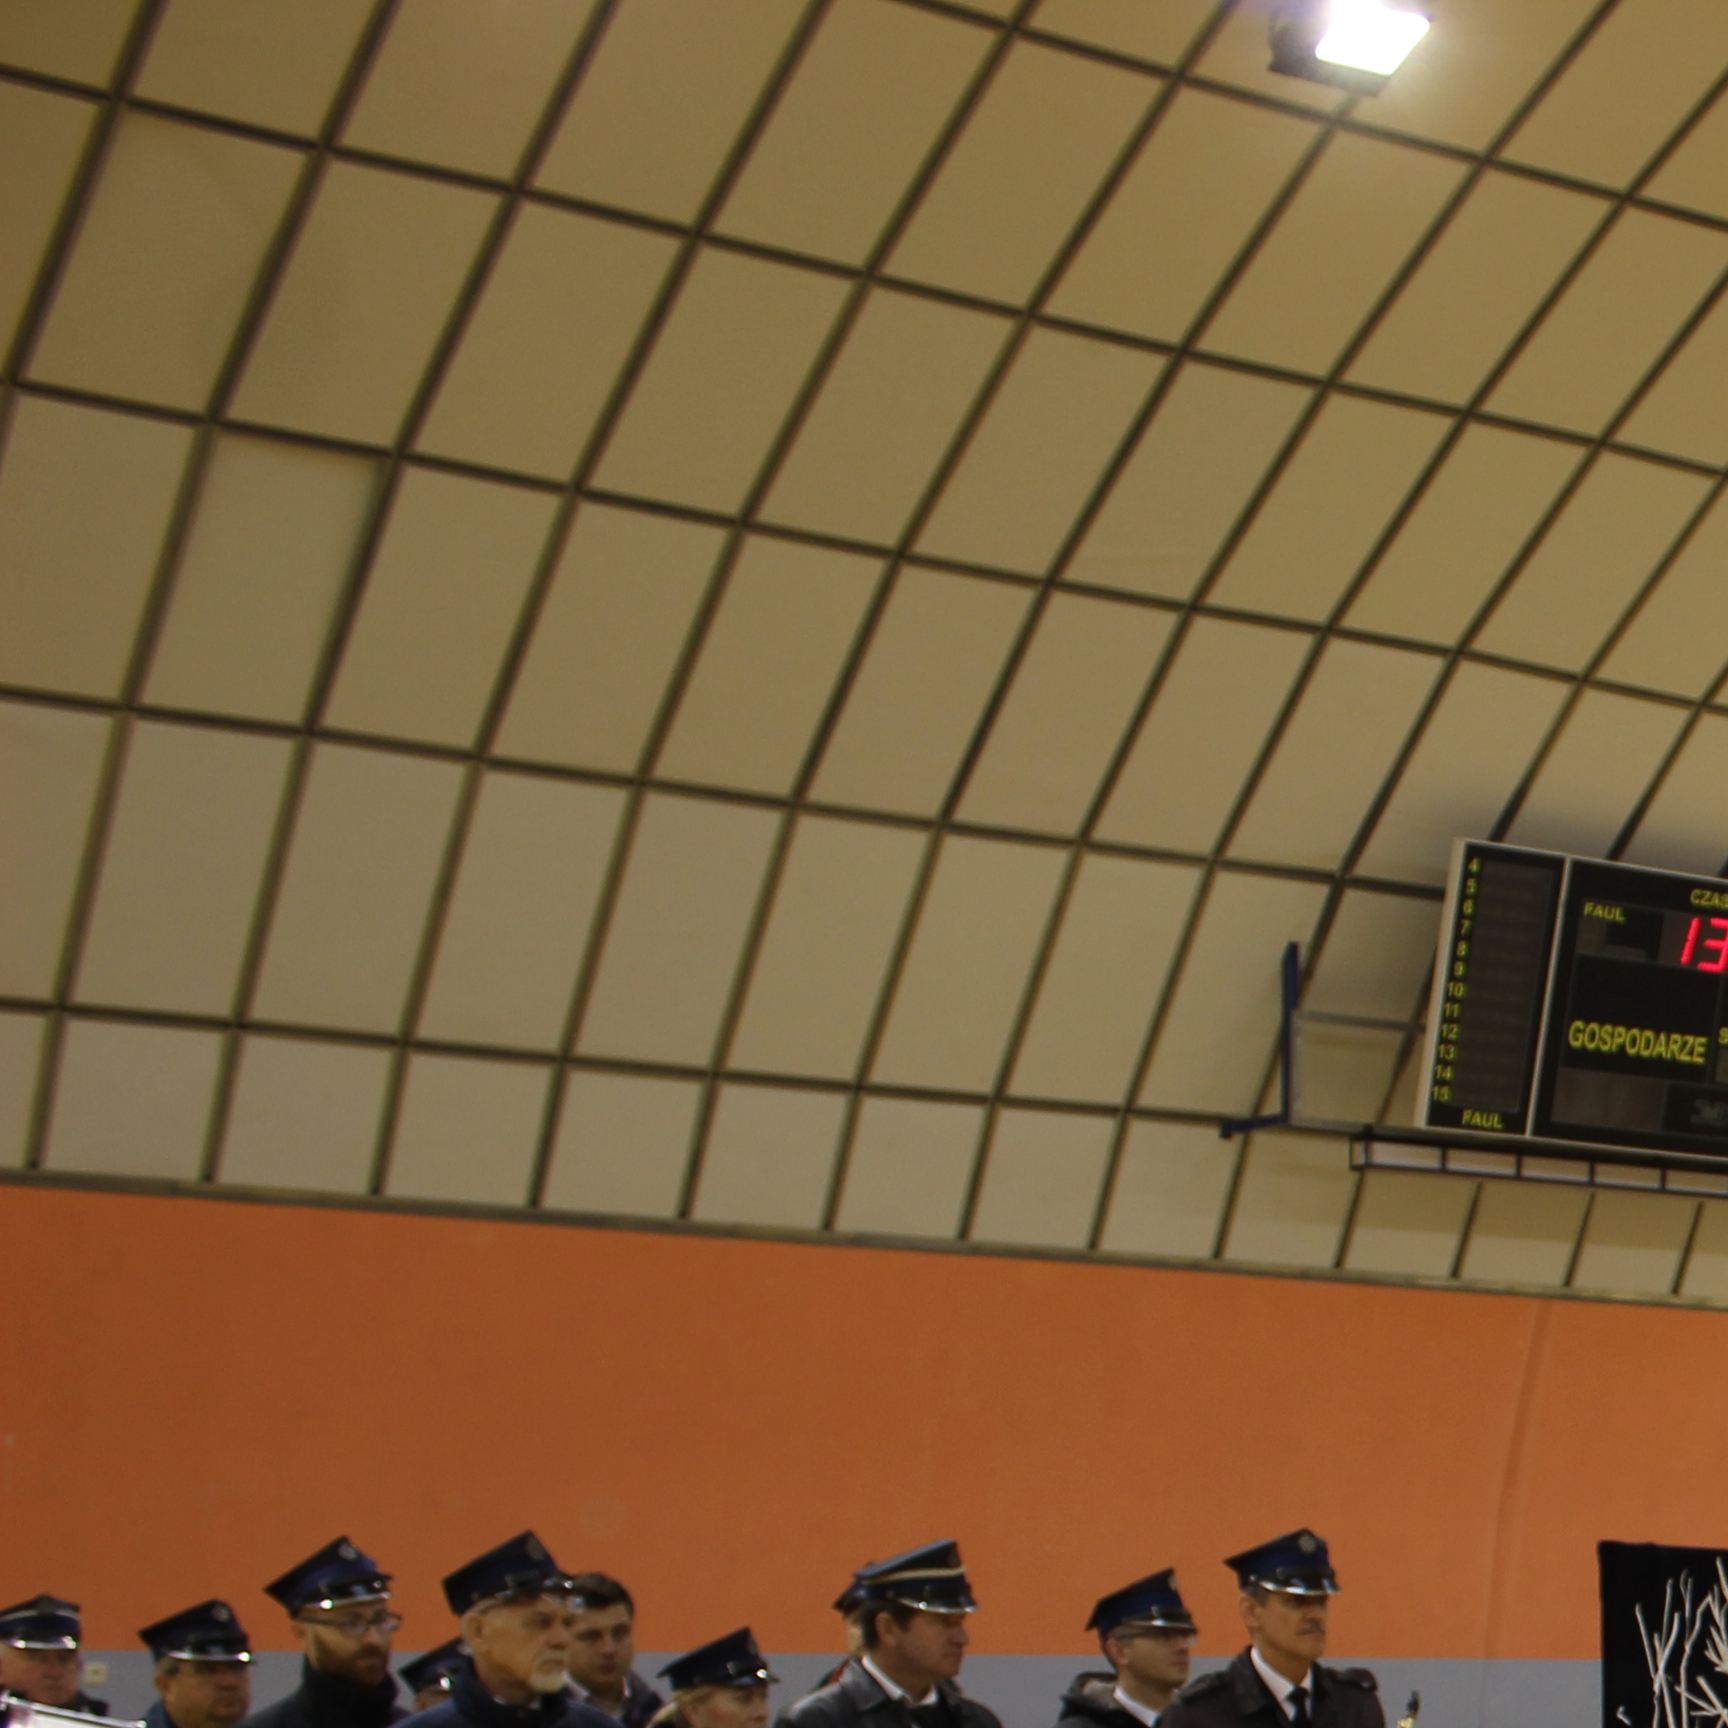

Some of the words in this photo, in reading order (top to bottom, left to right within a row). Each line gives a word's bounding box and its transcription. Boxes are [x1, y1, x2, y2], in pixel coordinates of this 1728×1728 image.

[1468, 857, 1481, 873] 4
[1466, 877, 1478, 894] 5
[1463, 898, 1475, 915] 6
[1583, 901, 1627, 923] FAUL
[1460, 919, 1472, 935] 7
[1457, 940, 1469, 957] 8
[1454, 961, 1466, 977] 9
[1447, 981, 1465, 998] 10
[1444, 1002, 1460, 1019] 11
[1441, 1023, 1459, 1040] 12
[1568, 1019, 1708, 1065] GOSPODARZE
[1438, 1043, 1456, 1060] 13
[1434, 1064, 1452, 1080] 14
[1462, 1109, 1503, 1129] FAUL
